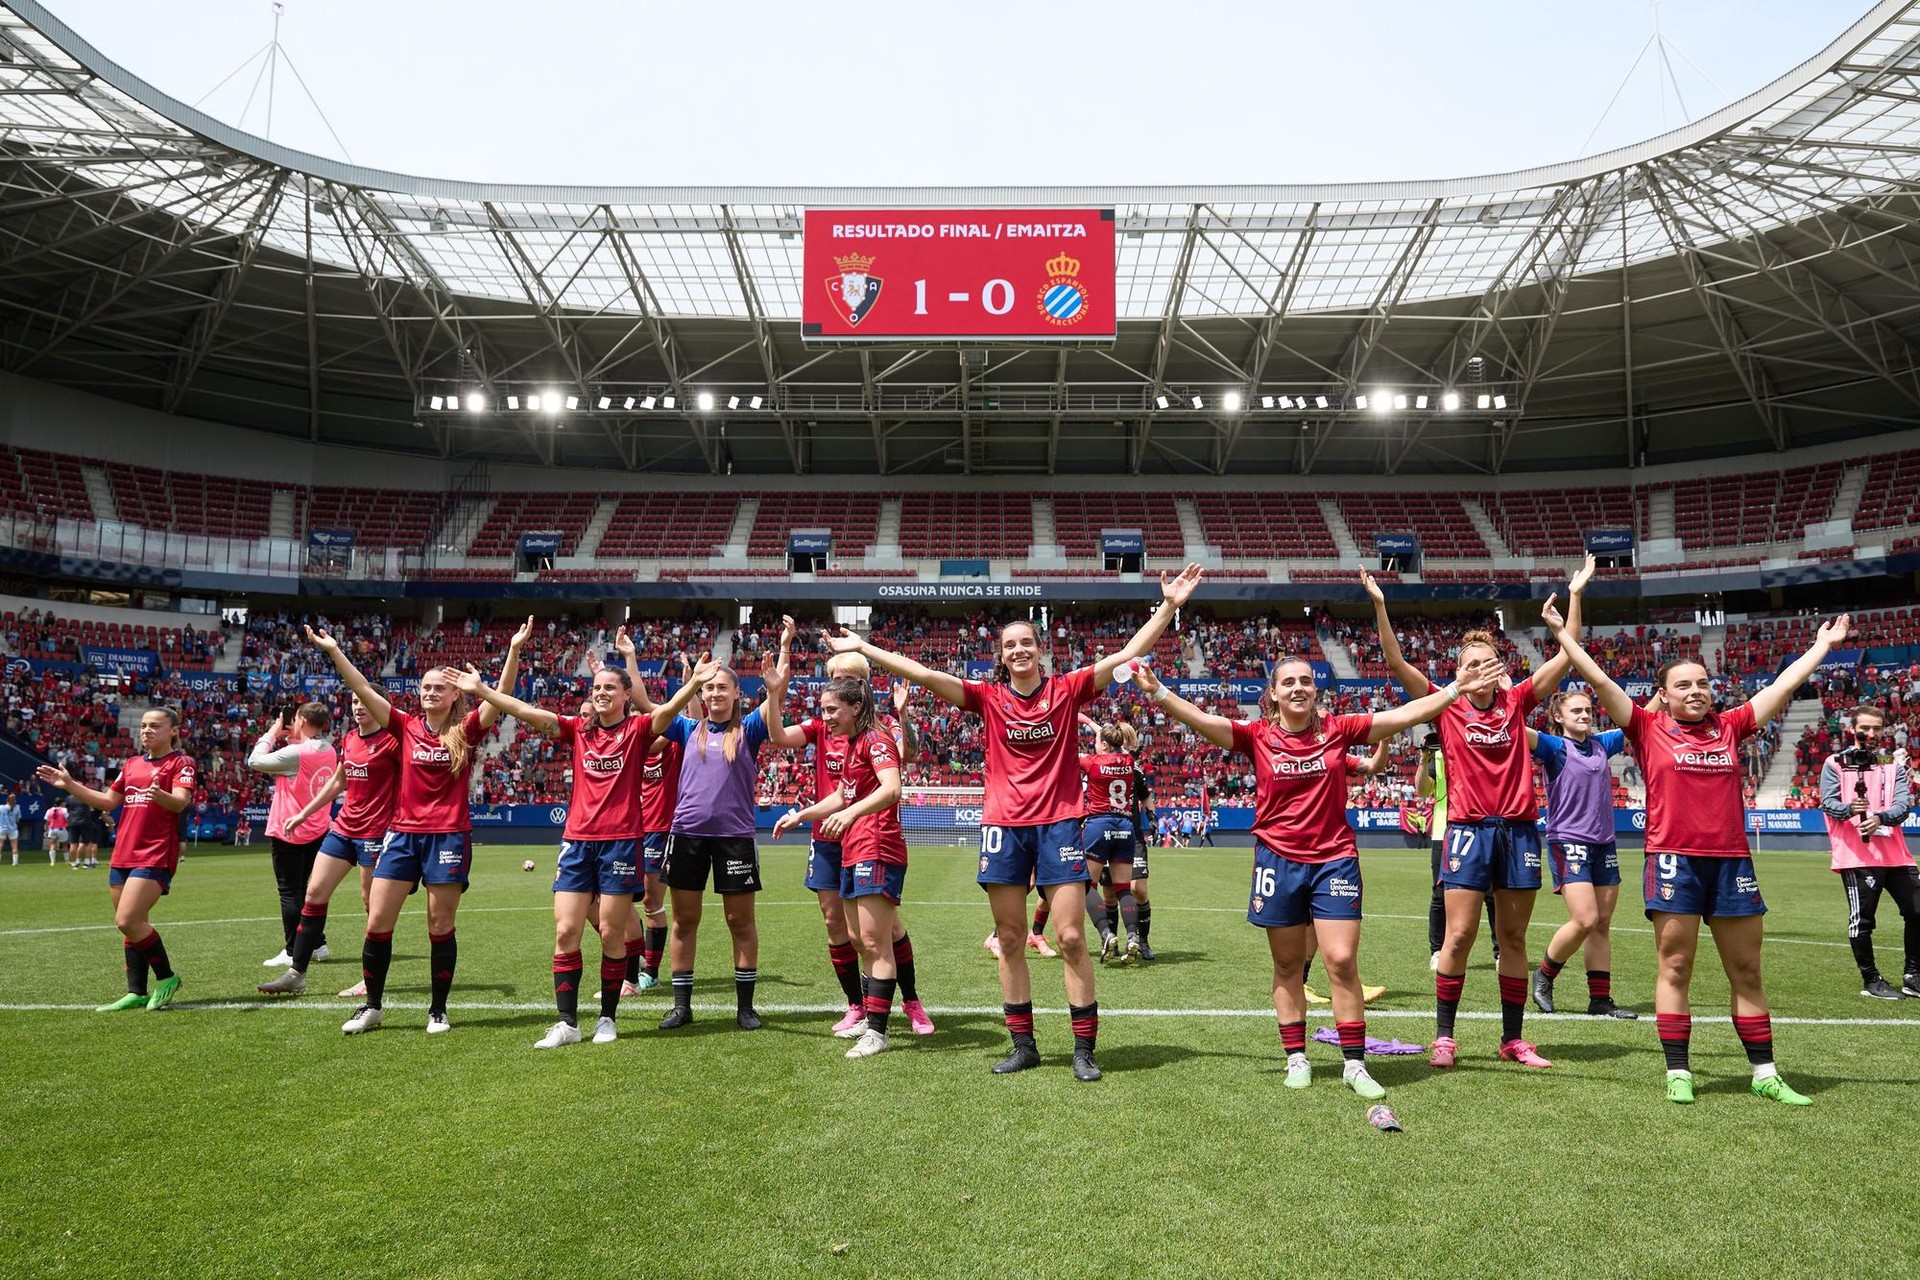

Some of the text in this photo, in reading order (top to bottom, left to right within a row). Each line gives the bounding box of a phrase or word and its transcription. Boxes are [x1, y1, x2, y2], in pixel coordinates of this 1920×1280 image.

[832, 224, 934, 238] RESULTADO
[939, 224, 991, 238] FINAL
[1006, 223, 1087, 238] EMAITZA
[913, 279, 929, 315] 1
[982, 278, 1015, 315] 0
[1050, 277, 1089, 300] ESPANYOL
[1044, 303, 1090, 326] BARCELONA
[878, 586, 1042, 596] OSASUNA NUNCA SE RINDE
[107, 661, 149, 672] NAARRA
[108, 654, 149, 664] DIARIO DE
[1006, 721, 1055, 740] verleal
[1465, 728, 1512, 744] verleal
[412, 749, 450, 762] verlea
[582, 756, 624, 770] verleal
[1673, 750, 1734, 766] verleal
[1100, 765, 1133, 775] VANESSA
[1271, 756, 1328, 774] verleal
[1108, 779, 1128, 810] 8
[469, 812, 502, 820] CaixaBank
[1370, 811, 1400, 819] IZQUIER
[1767, 812, 1801, 820] DIARIO DE
[1767, 820, 1802, 829] NAVARRA
[981, 825, 1003, 854] 10
[1451, 828, 1476, 856] 17
[1563, 843, 1588, 861] 25
[1658, 853, 1678, 880] 9
[1255, 866, 1276, 897] 16
